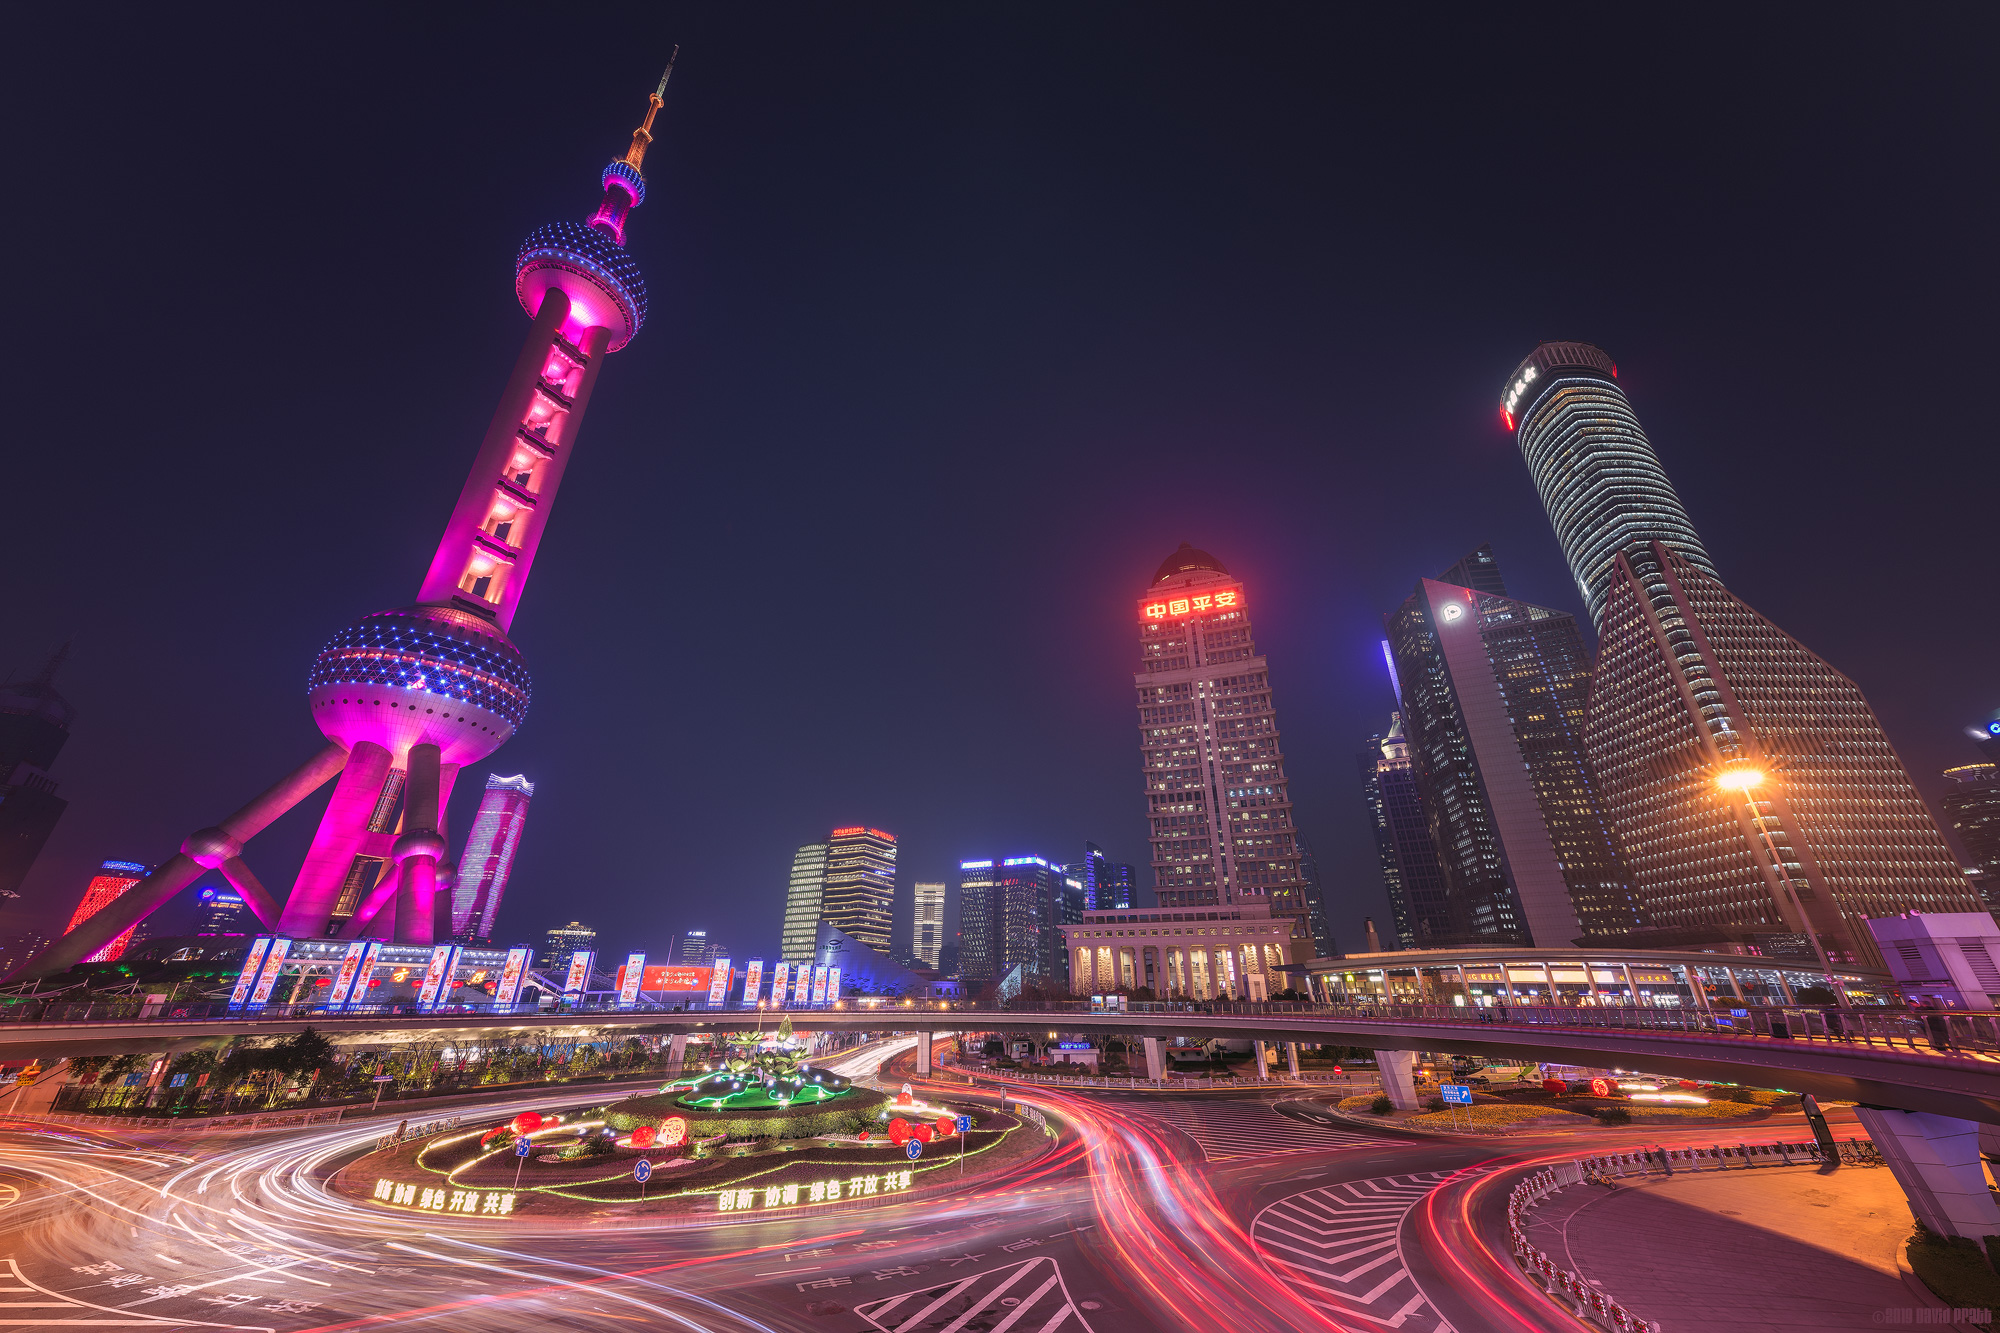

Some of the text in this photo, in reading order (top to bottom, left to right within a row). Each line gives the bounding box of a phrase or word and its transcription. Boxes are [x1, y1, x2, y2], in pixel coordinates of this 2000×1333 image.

[1146, 592, 1236, 618] 中国平安
[374, 1179, 517, 1215] 创新 协调 绿色 开放 共享
[719, 1170, 912, 1211] 创新 协调 绿色 开放 共享
